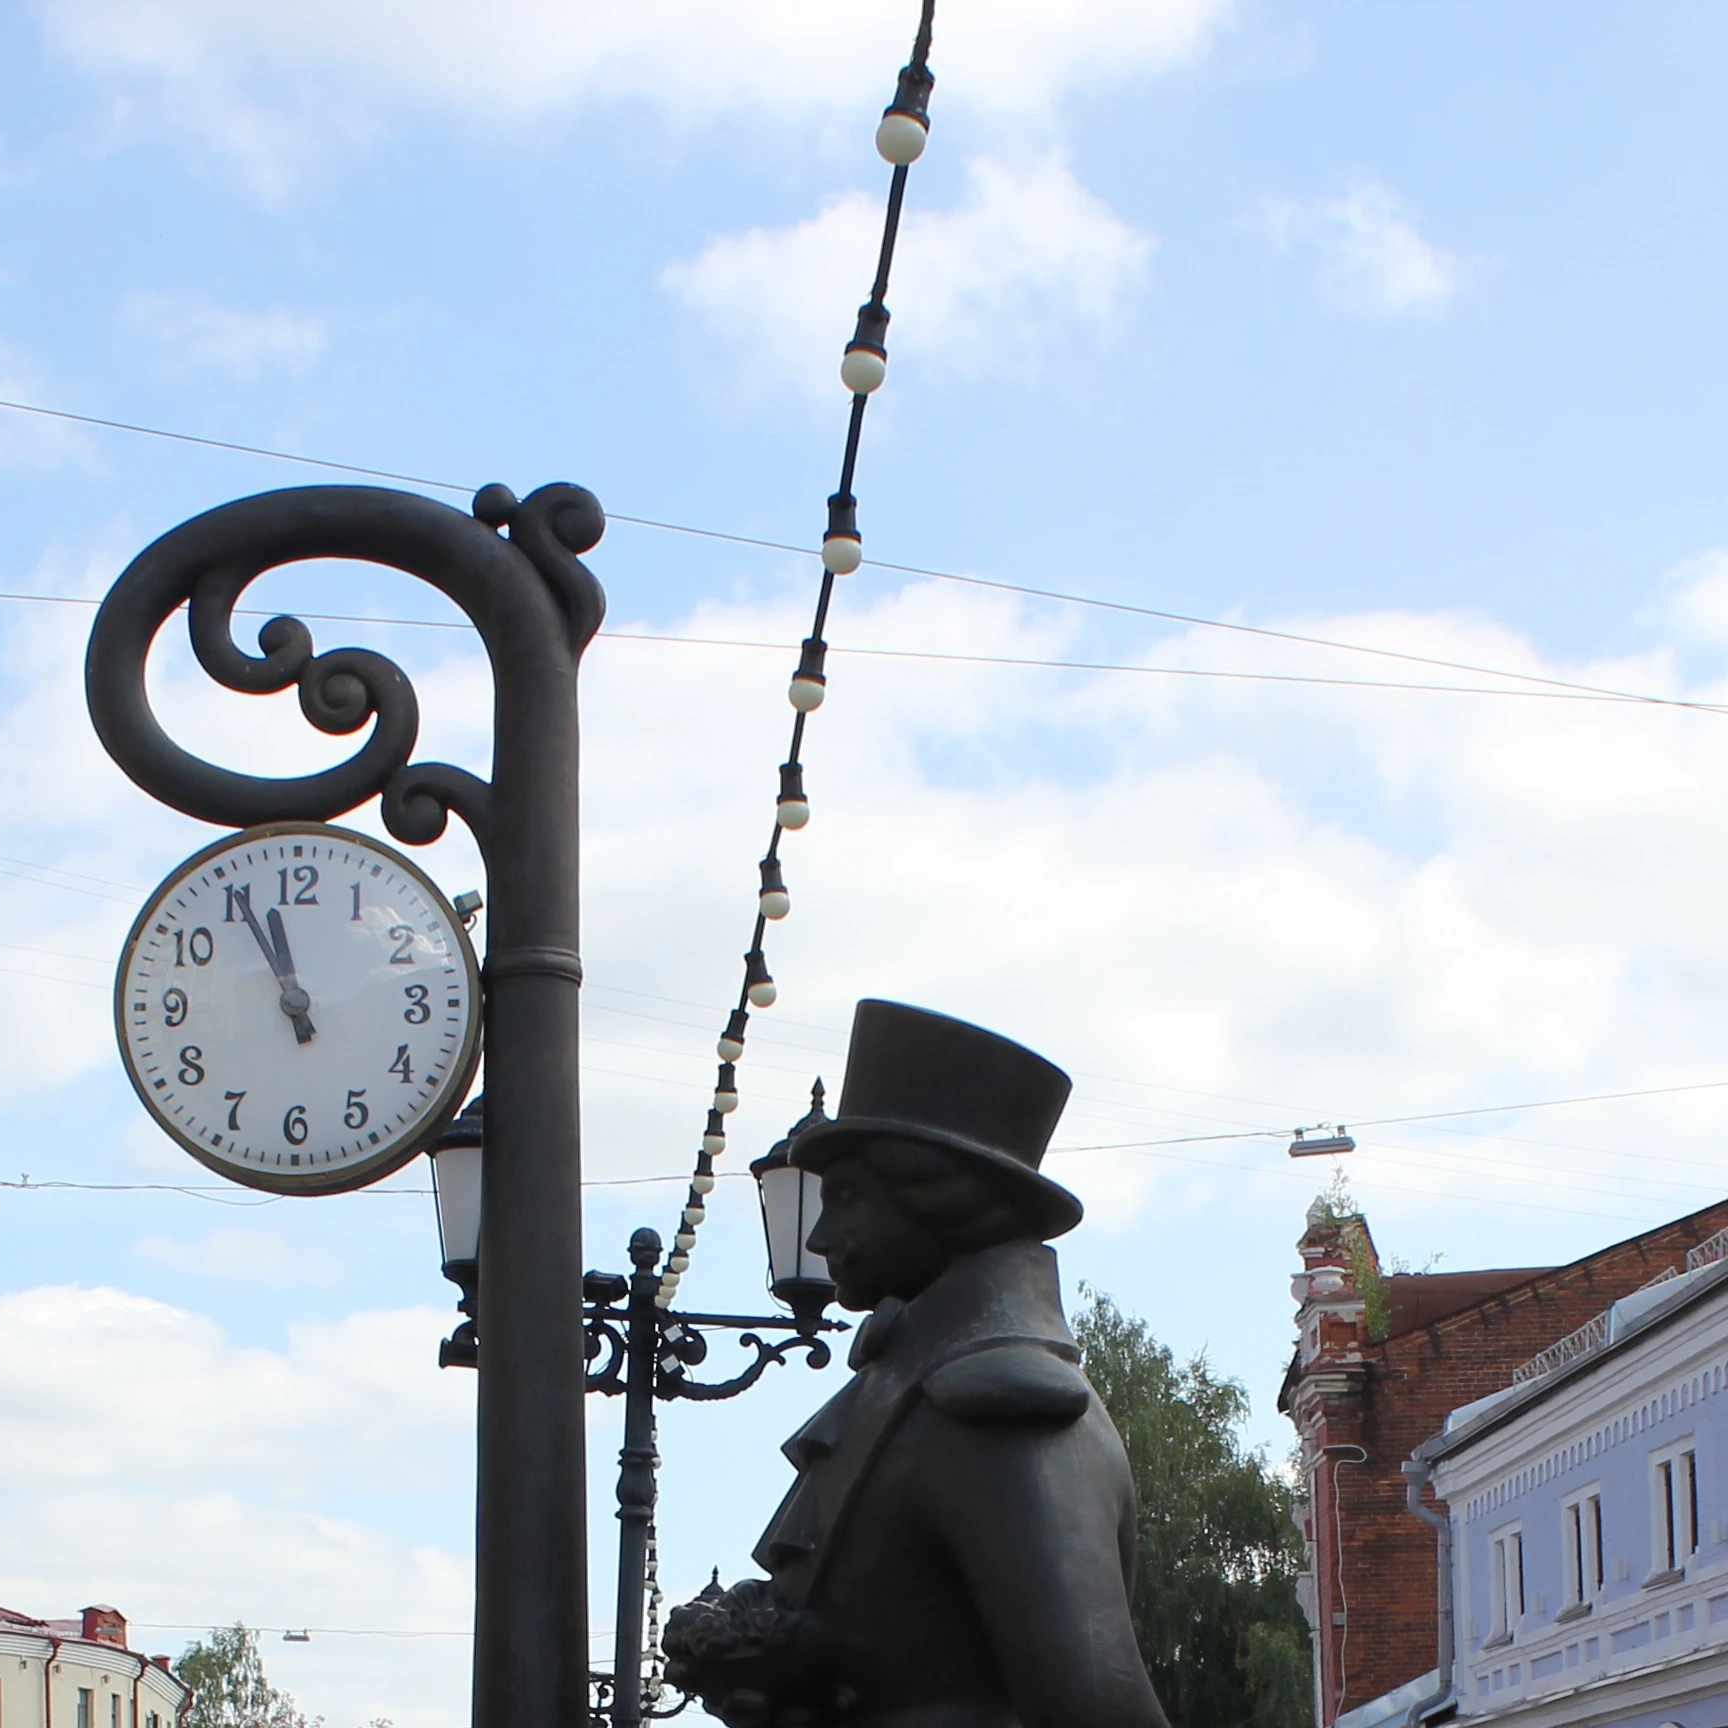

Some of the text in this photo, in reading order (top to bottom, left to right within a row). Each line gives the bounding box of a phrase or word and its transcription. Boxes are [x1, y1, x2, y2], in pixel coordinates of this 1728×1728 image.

[223, 883, 251, 922] 11
[277, 866, 319, 905] 12
[350, 881, 362, 920] 1
[173, 927, 214, 967] 10
[389, 925, 415, 965] 2
[163, 988, 188, 1026] 9
[404, 985, 431, 1024] 3
[178, 1045, 204, 1085] 8
[388, 1043, 414, 1083] 4
[224, 1091, 247, 1130] 7
[283, 1105, 308, 1145] 6
[343, 1089, 368, 1129] 5
